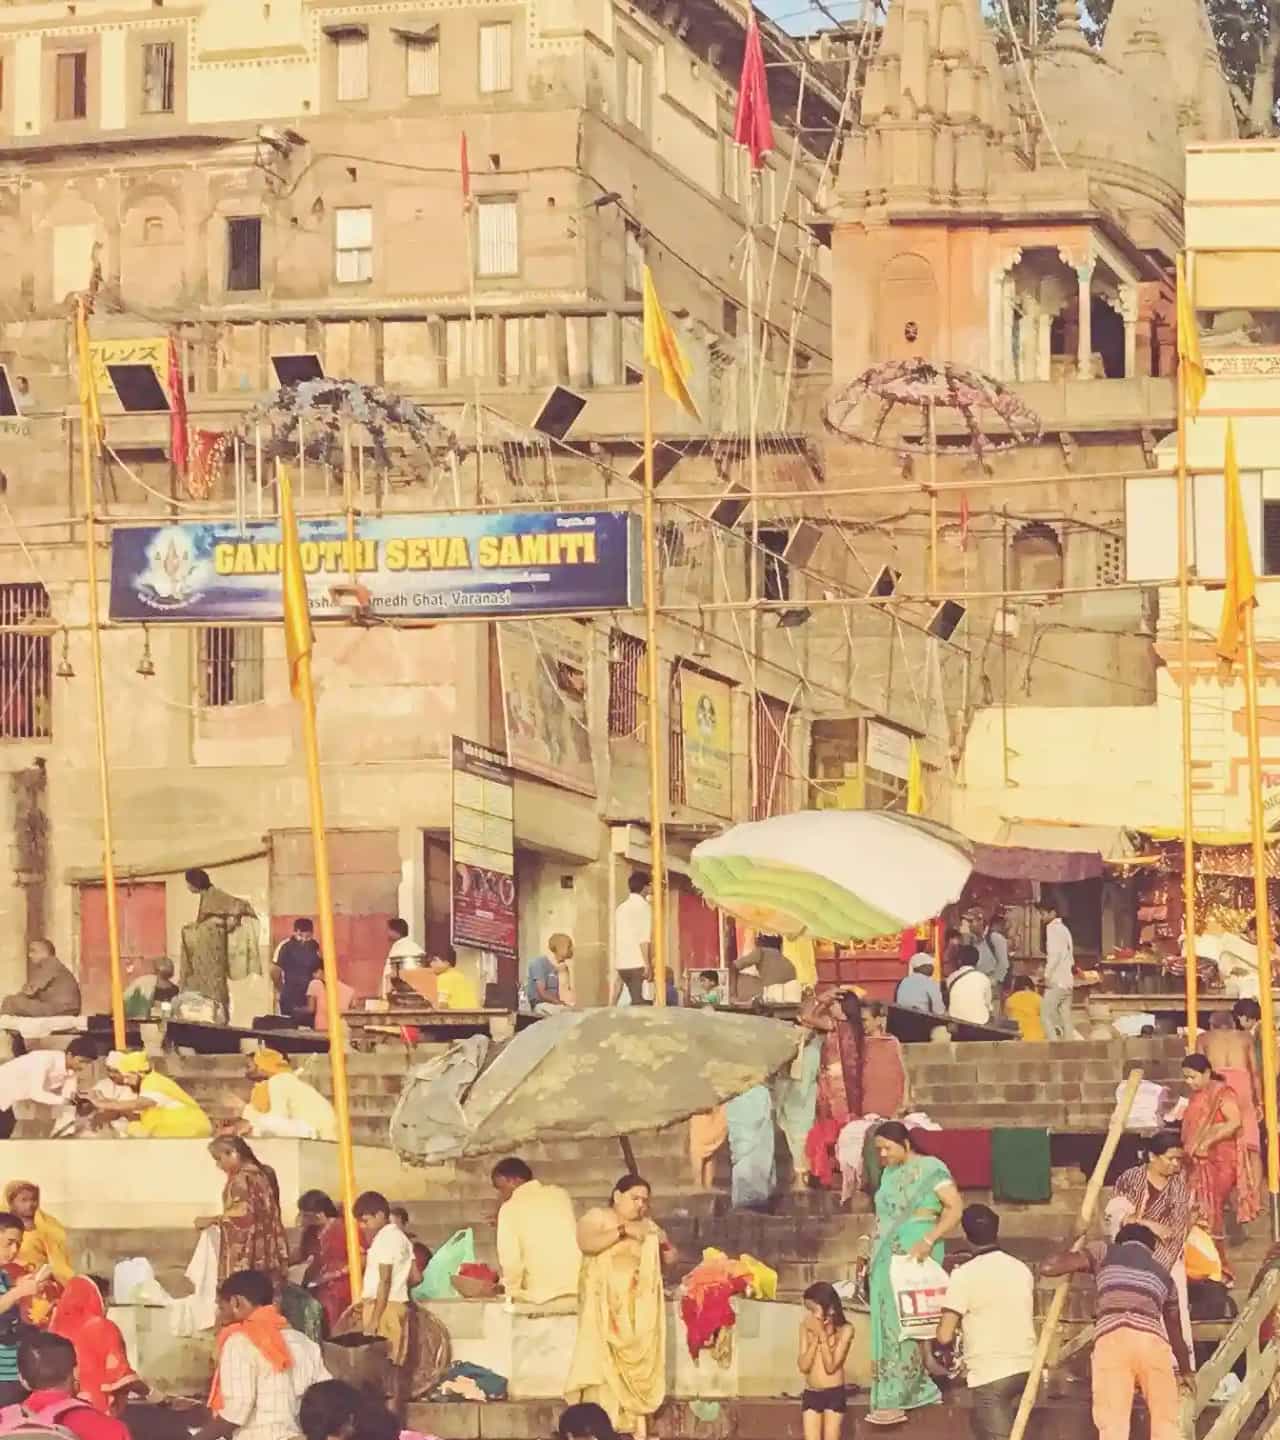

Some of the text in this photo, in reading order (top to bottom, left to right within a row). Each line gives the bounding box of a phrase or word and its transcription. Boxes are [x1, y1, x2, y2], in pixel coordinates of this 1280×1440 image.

[214, 531, 597, 577] GANOTRI SEVA SAMITI
[452, 588, 512, 606] Varanasi
